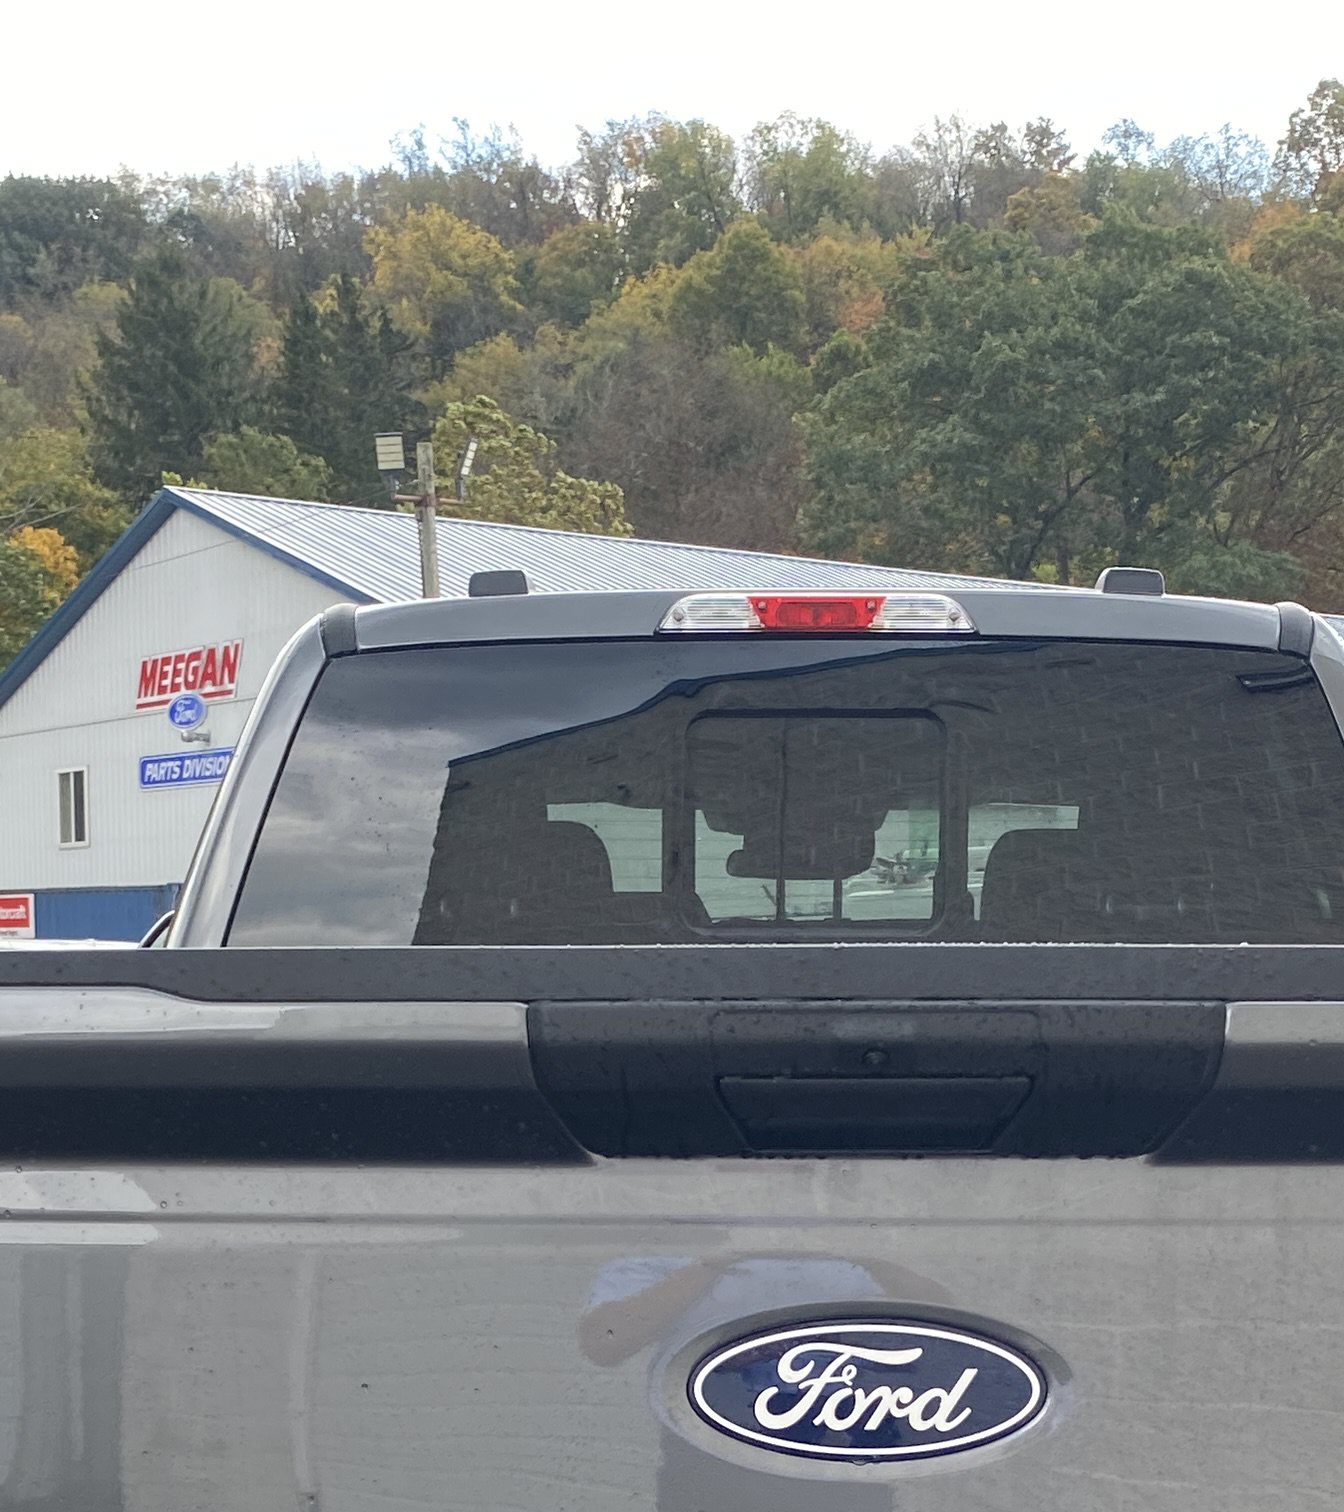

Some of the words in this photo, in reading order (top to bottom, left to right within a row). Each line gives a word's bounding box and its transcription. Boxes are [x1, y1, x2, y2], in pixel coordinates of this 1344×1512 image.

[137, 643, 240, 699] MEEGAN
[144, 760, 182, 783] PARTS
[753, 1341, 979, 1433] Ford
